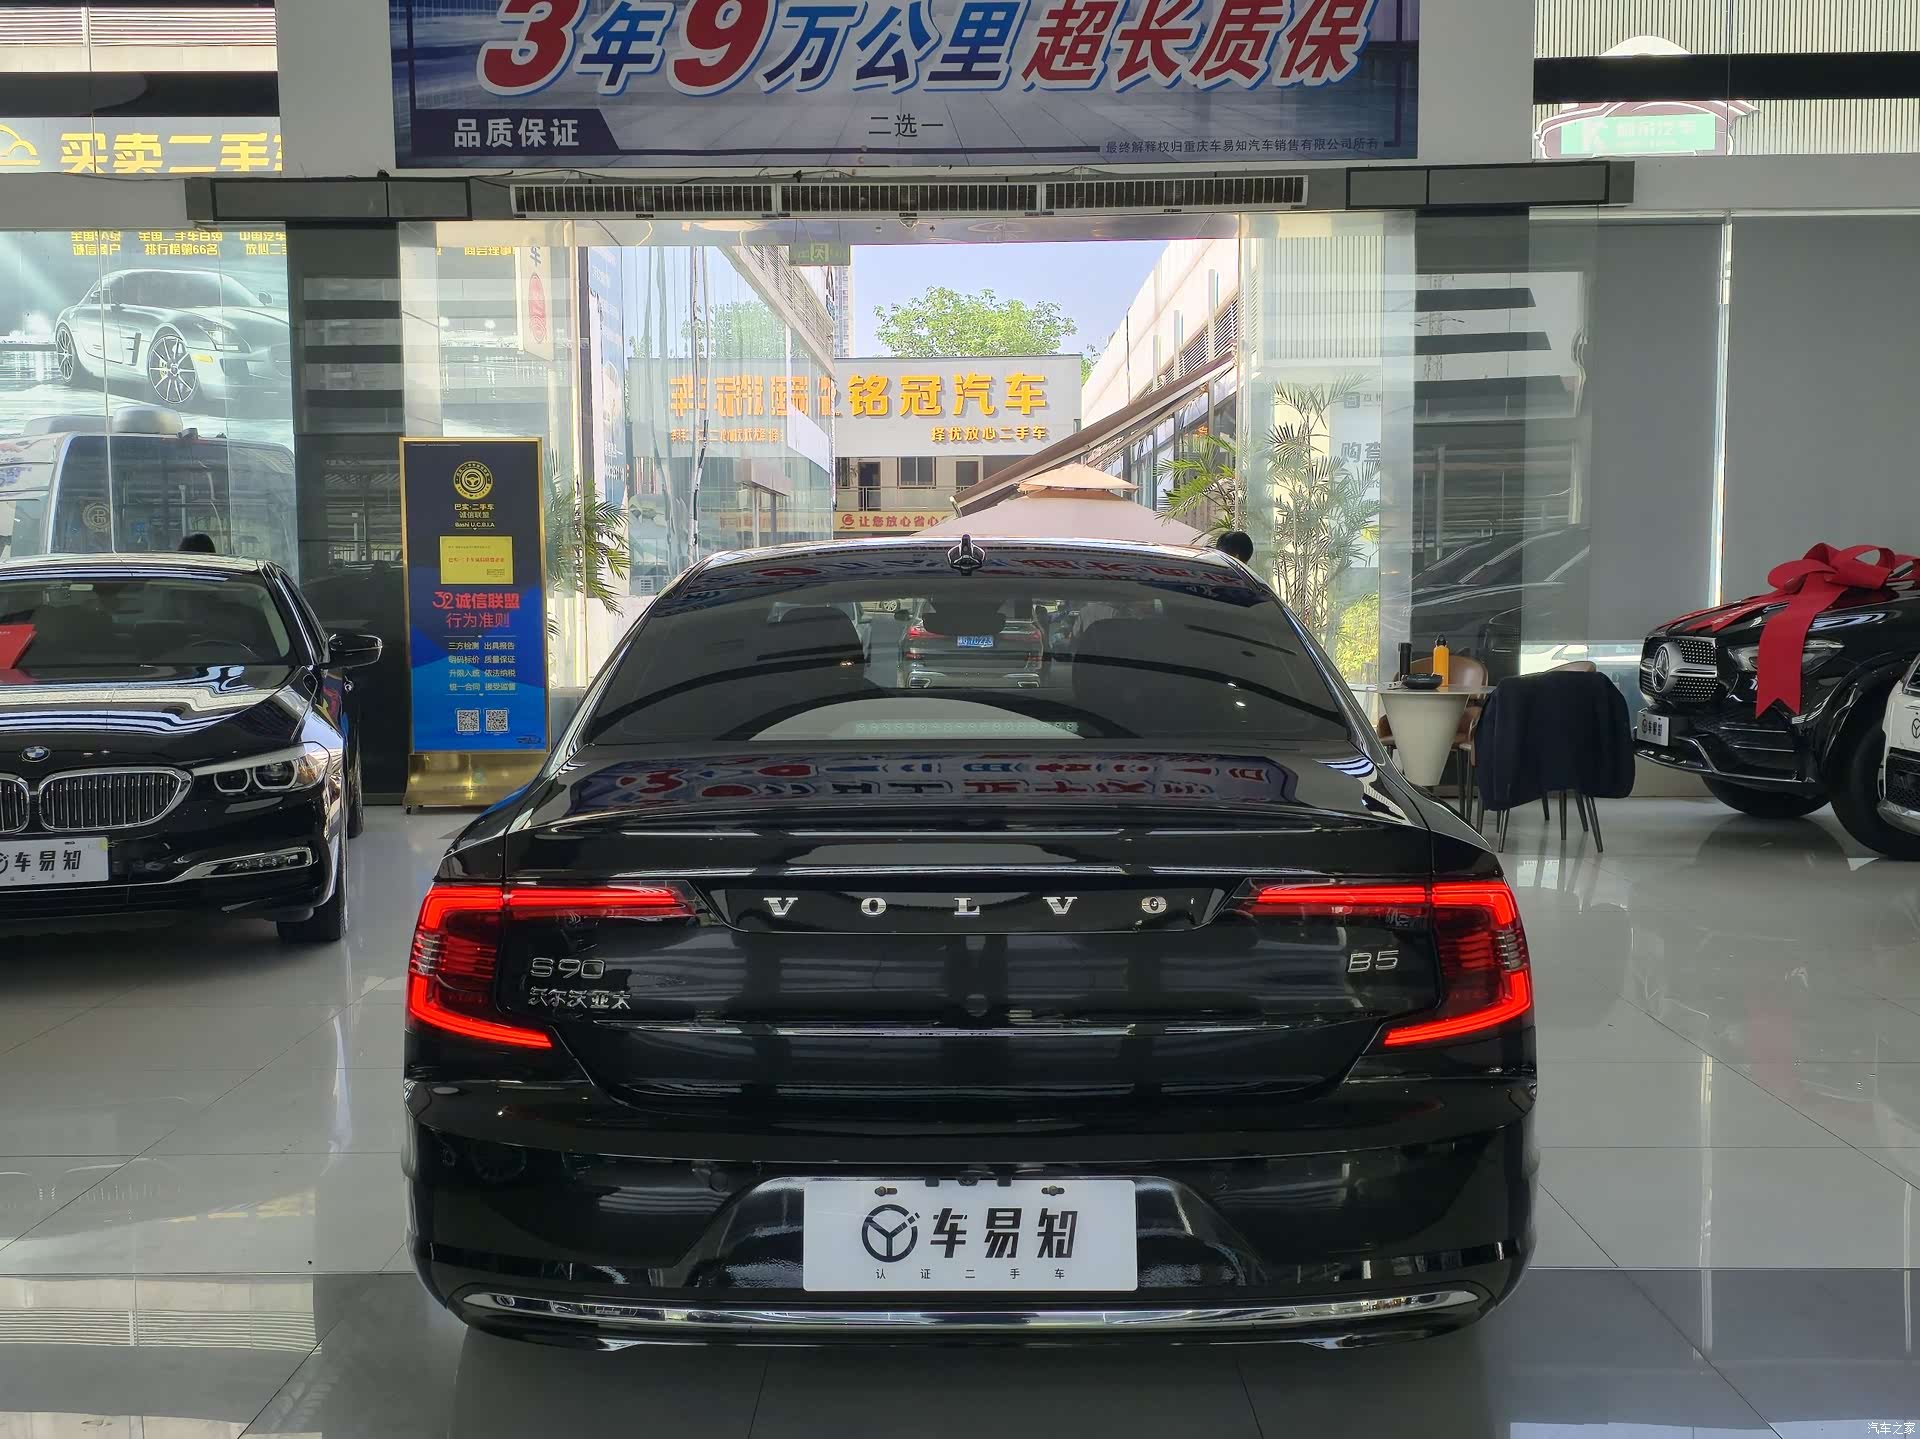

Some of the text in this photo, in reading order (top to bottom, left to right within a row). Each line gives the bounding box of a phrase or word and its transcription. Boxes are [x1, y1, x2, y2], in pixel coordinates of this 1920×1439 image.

[478, 0, 1376, 95] 3年9万公里超长质保
[453, 117, 580, 148] 品质保证
[868, 113, 944, 138] 二选一
[60, 132, 283, 173] 买卖二手
[1105, 137, 1379, 153] 最终解释权归重庆车易知汽车销售有限公司所有
[848, 373, 1048, 417] 铭冠汽车
[931, 424, 1047, 442] 择优放心二手车
[446, 612, 510, 629] 行为准则
[14, 849, 82, 873] 车易知
[763, 896, 1167, 917] VOLVO
[529, 956, 606, 980] S90
[1347, 949, 1400, 973] B5
[528, 985, 632, 1010] 沃尔沃亚太
[930, 1207, 1079, 1259] 车易知
[875, 1267, 1066, 1281] 认证二手车
